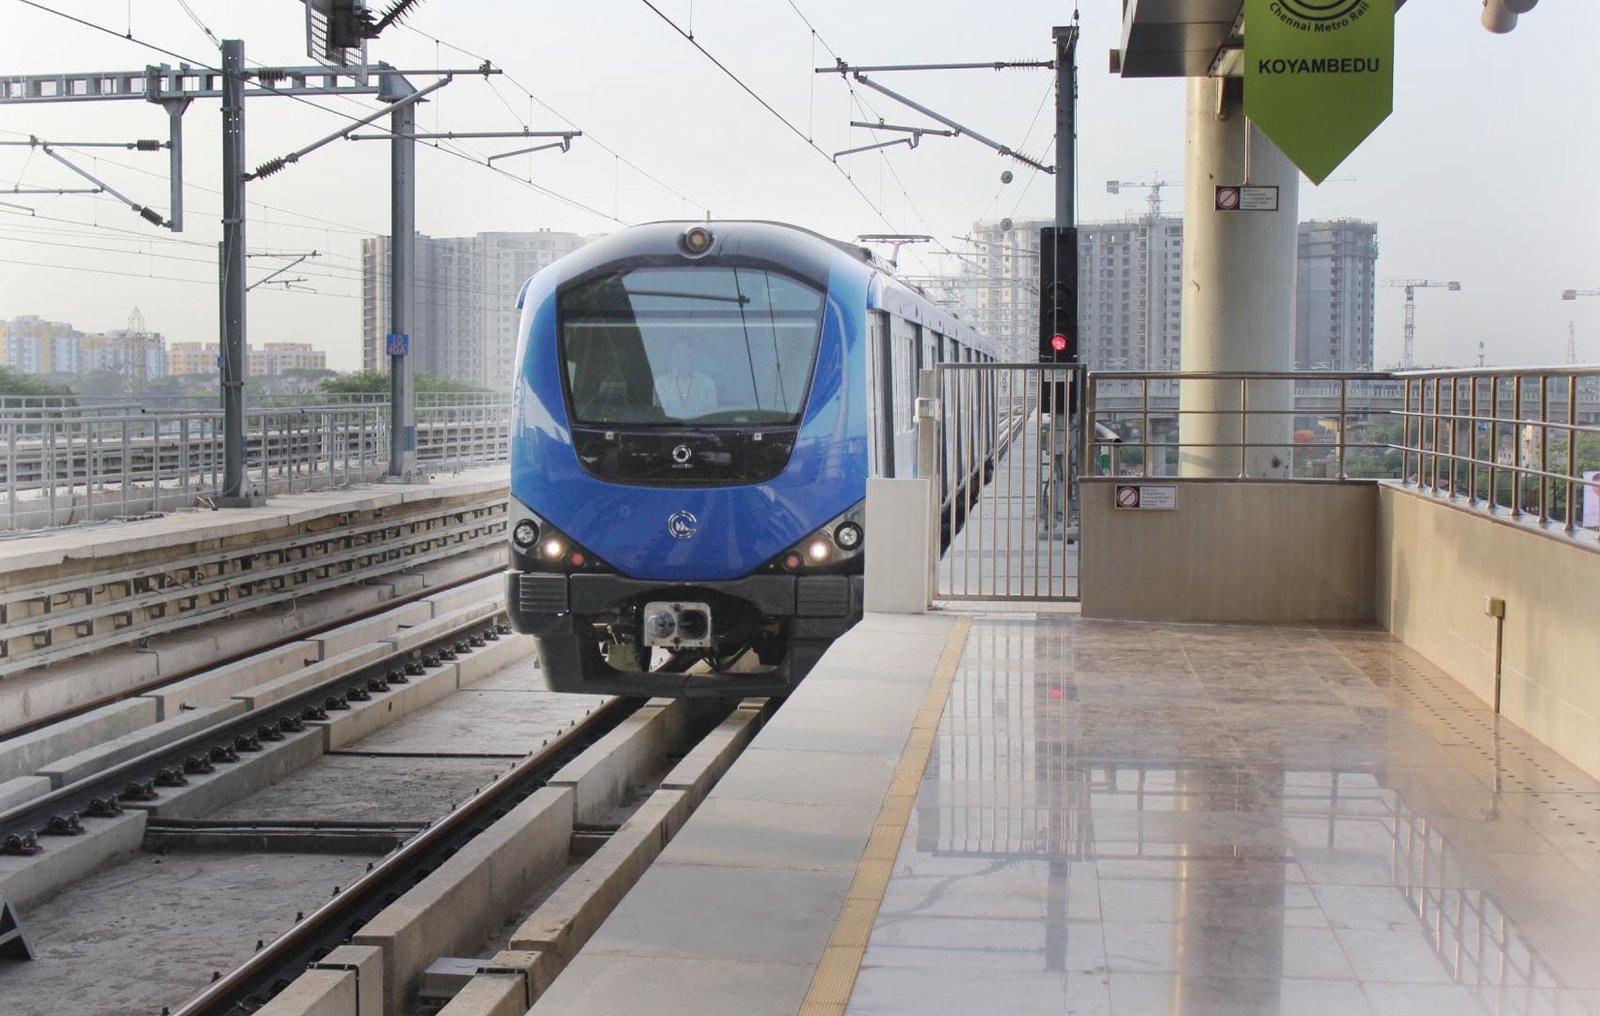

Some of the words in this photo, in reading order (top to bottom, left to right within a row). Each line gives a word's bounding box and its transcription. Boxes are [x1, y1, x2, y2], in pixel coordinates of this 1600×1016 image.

[1269, 2, 1311, 32] Chennai
[1314, 20, 1349, 32] Metro
[1349, 1, 1369, 21] Rail
[1259, 58, 1380, 74] KOYAMBEDU
